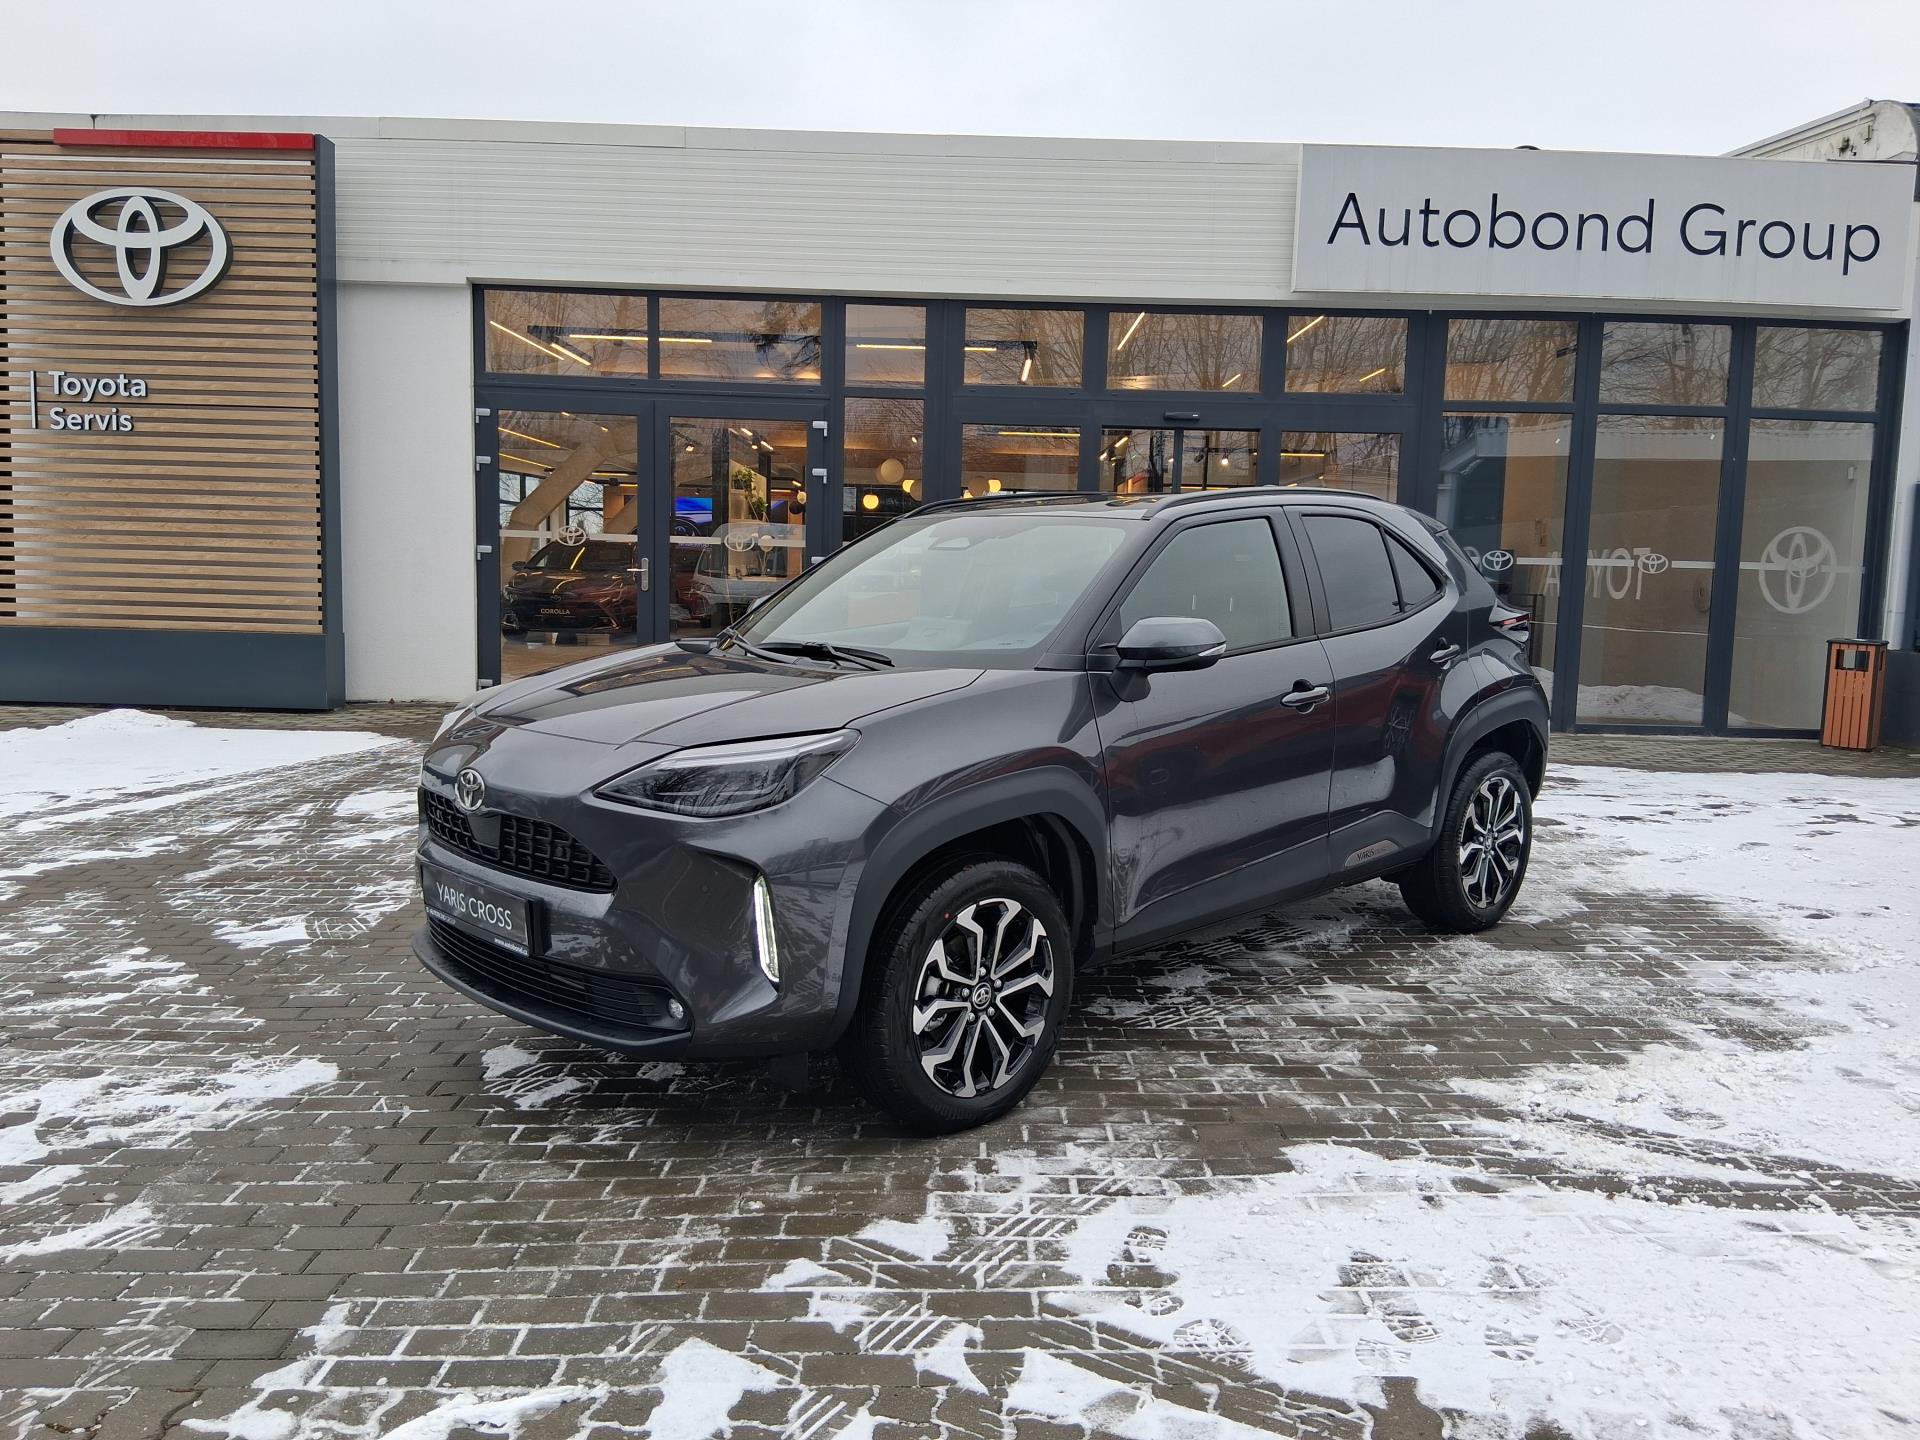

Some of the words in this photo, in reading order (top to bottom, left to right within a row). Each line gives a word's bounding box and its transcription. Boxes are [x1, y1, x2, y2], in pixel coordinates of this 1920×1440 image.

[1327, 192, 1655, 254] Autobond
[1680, 203, 1881, 276] Group
[48, 371, 147, 402] Toyota
[49, 407, 133, 432] Servis
[436, 881, 467, 913] YARIS
[468, 897, 513, 931] CROSS
